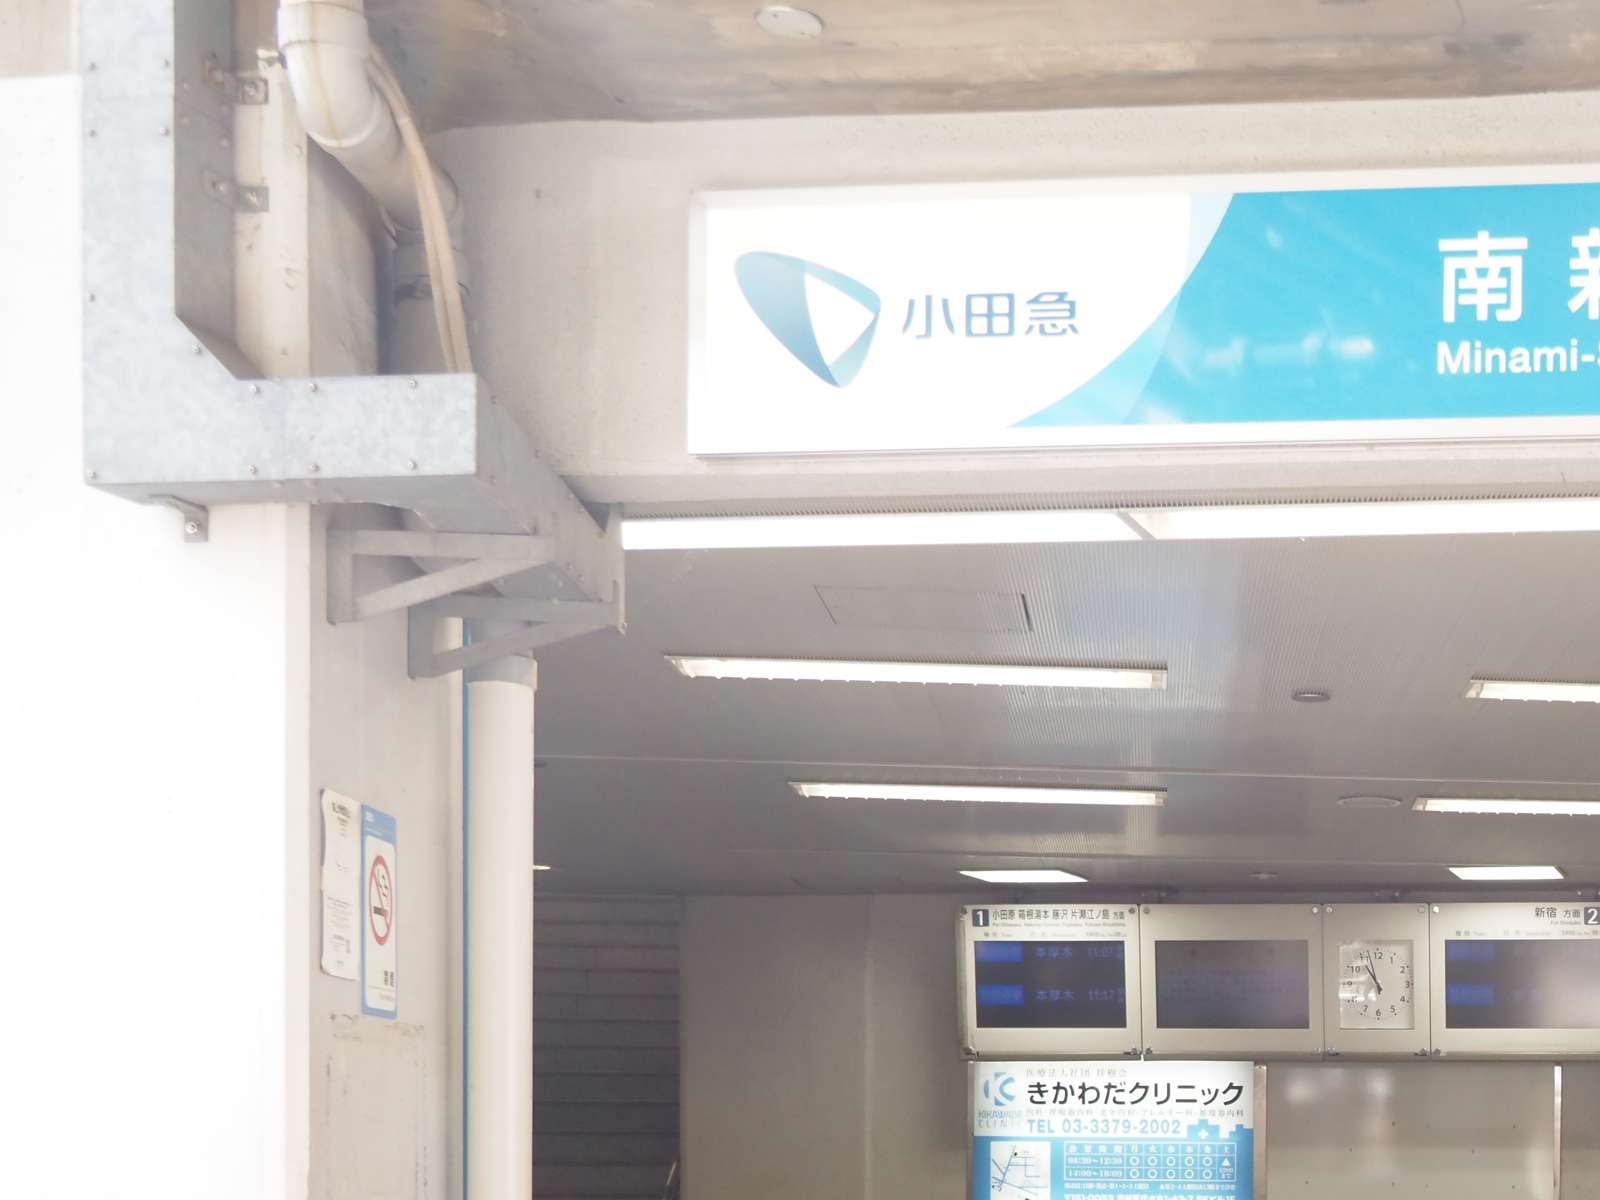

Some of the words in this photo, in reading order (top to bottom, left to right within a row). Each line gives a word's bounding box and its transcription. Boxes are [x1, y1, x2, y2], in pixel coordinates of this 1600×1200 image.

[900, 288, 1080, 340] 小田急
[976, 910, 983, 926] 1
[992, 909, 1015, 920] 小田原
[1071, 909, 1110, 920] 片瀬江ノ島
[1113, 911, 1125, 920] 方面
[1534, 906, 1557, 918] 新宿
[1563, 909, 1581, 918] 方面
[1587, 908, 1598, 924] 2
[1027, 1081, 1244, 1106] きかわだクリニック
[1027, 1119, 1055, 1134] TEL
[1062, 1119, 1181, 1134] 03-3379-2002
